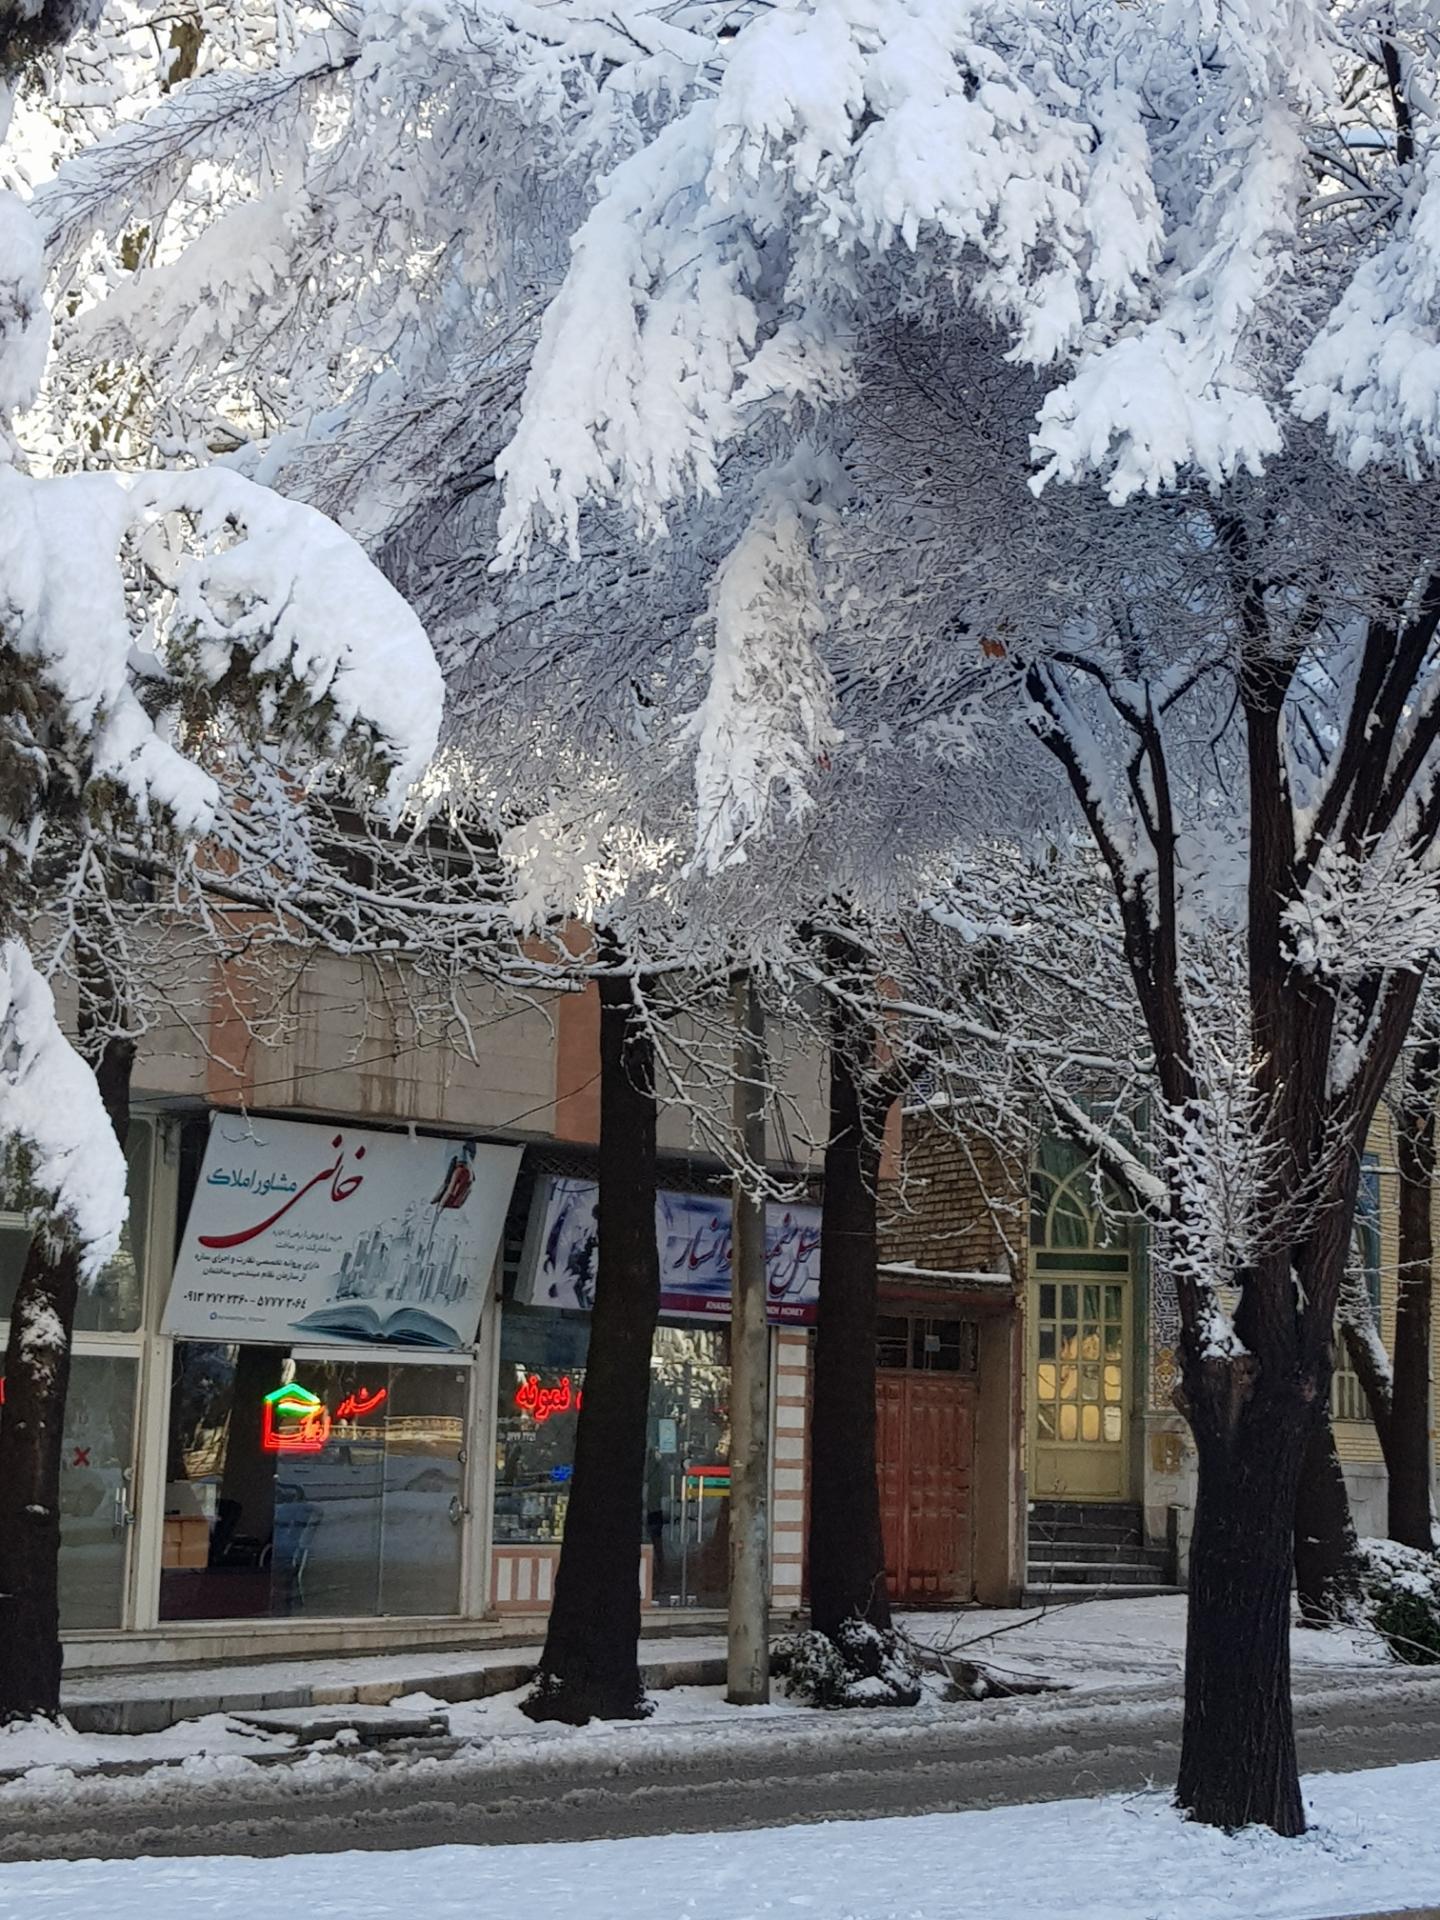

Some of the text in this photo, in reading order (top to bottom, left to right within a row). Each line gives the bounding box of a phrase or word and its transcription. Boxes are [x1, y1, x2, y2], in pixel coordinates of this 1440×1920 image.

[206, 1167, 297, 1196] مشاور املاک
[197, 1133, 367, 1249] خانی
[211, 1254, 231, 1264] اجرای
[236, 1256, 255, 1265] نظارت
[255, 1257, 282, 1267] تخصصی
[284, 1259, 302, 1269] پروانه
[302, 1260, 320, 1271] دارای
[202, 1267, 231, 1276] ساختمان
[232, 1269, 261, 1278] مهندسی
[261, 1270, 275, 1279] نظام
[275, 1270, 299, 1281] سازمان
[336, 1386, 387, 1418] مشاور
[516, 1374, 571, 1422] نمونه
